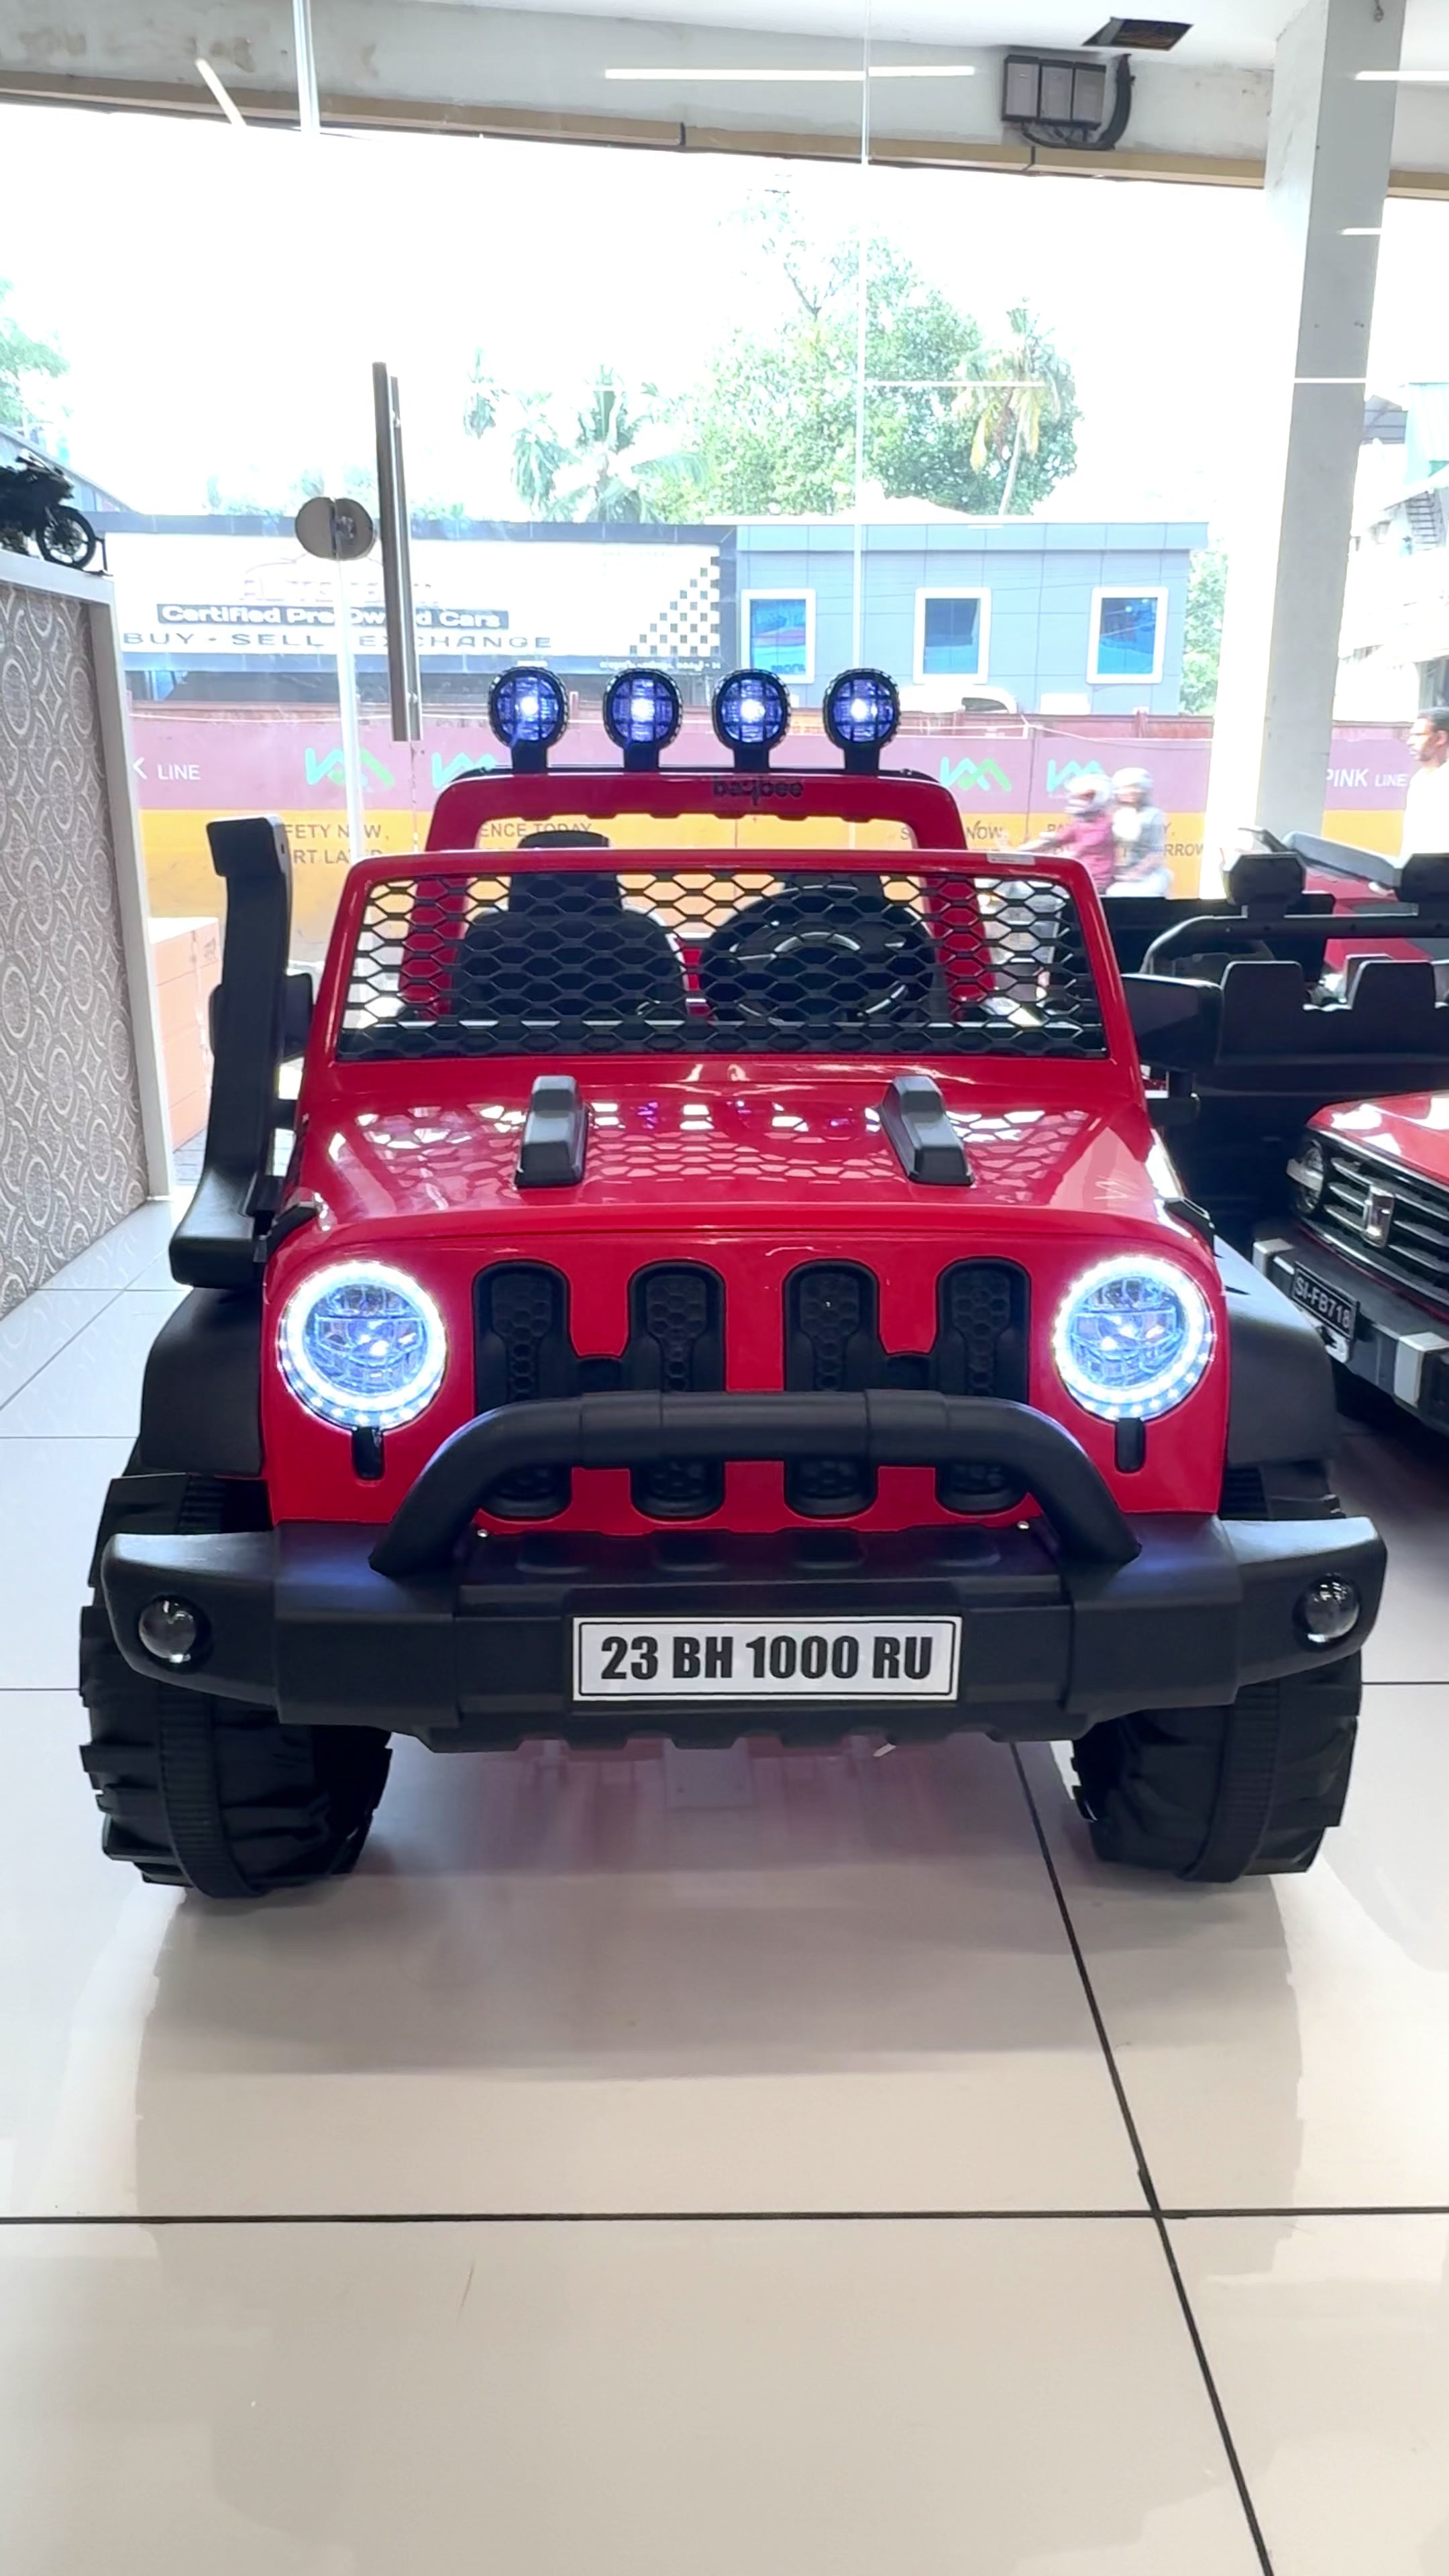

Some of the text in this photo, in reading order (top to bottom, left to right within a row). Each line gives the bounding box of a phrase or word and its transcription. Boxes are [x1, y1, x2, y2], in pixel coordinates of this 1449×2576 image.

[439, 610, 501, 628] Cars
[123, 633, 551, 649] BUY SELL EHANGE
[157, 763, 201, 780] LINE
[1375, 773, 1409, 787] LINE
[284, 824, 331, 839] FETY
[600, 1635, 933, 1680] 23 BH 1000 RU
